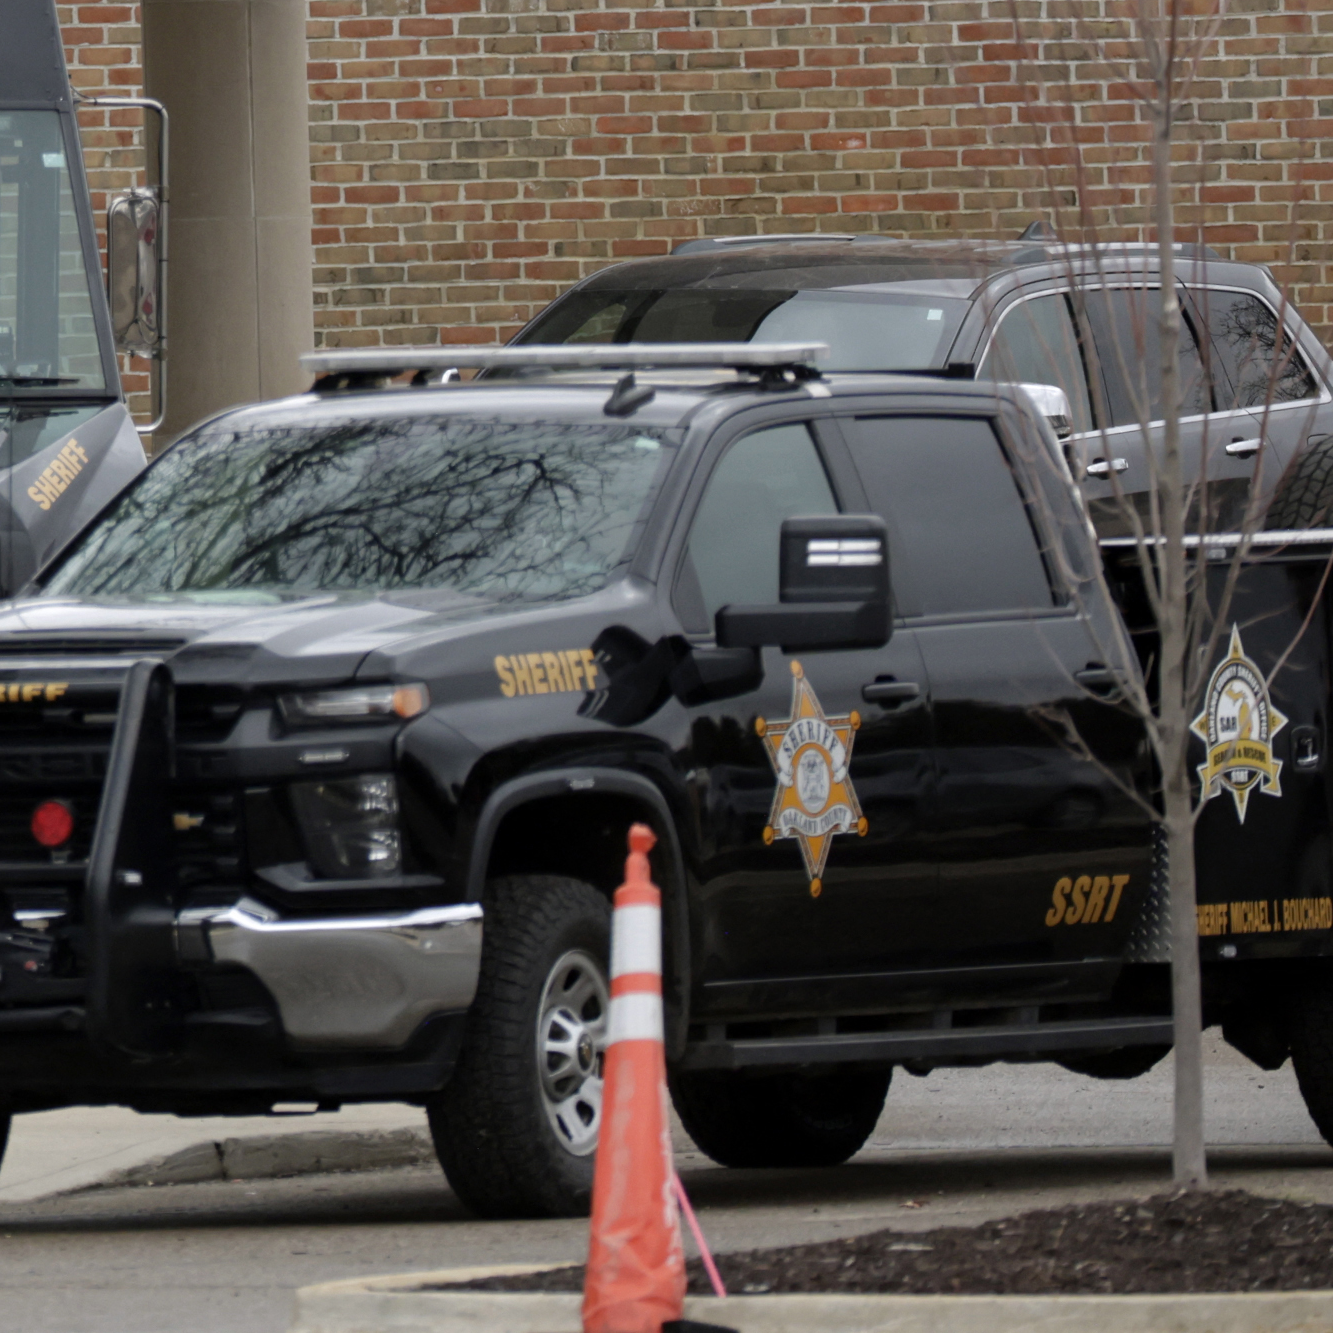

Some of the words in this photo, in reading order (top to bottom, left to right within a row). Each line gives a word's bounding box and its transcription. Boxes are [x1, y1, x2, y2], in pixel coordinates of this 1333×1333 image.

[27, 437, 89, 511] SHERIFF
[494, 648, 598, 698] SHERIFF
[783, 720, 839, 759] SHERIFF
[783, 810, 817, 834] OAKLAND
[1045, 873, 1130, 927] SSRT
[1196, 902, 1228, 936] HERIFF
[1230, 899, 1271, 934] MICHAEL
[1283, 896, 1333, 931] BOUCHARD
